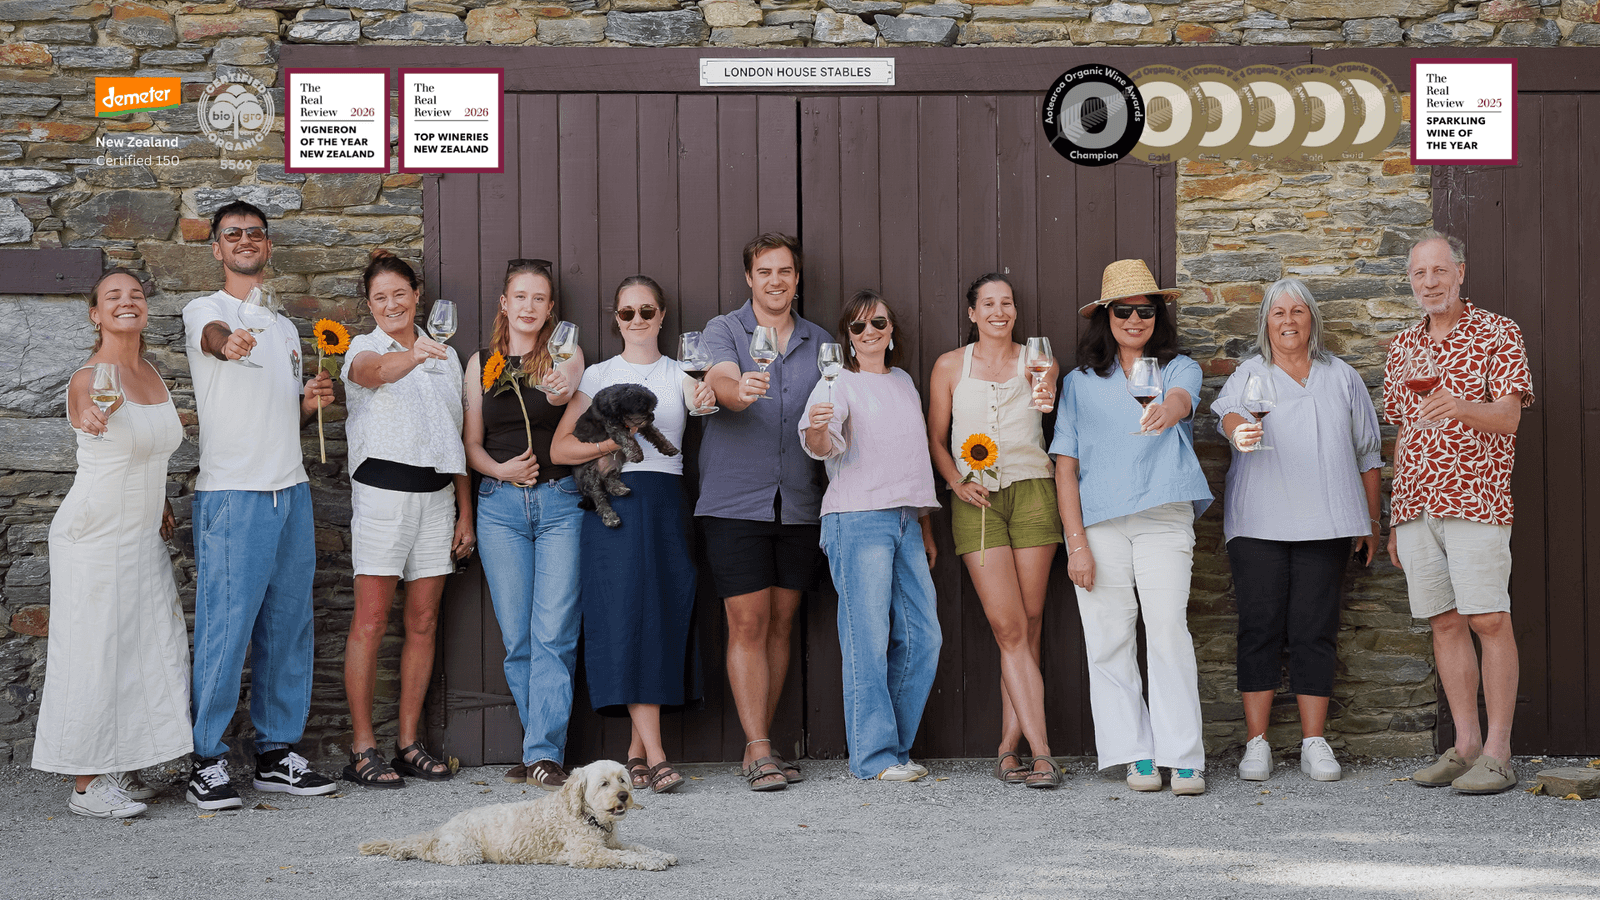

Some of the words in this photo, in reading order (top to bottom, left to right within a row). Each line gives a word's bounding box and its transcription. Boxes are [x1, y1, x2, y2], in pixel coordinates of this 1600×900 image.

[724, 67, 773, 77] LONDON
[777, 67, 817, 77] HOUSE
[820, 67, 872, 77] STABLES
